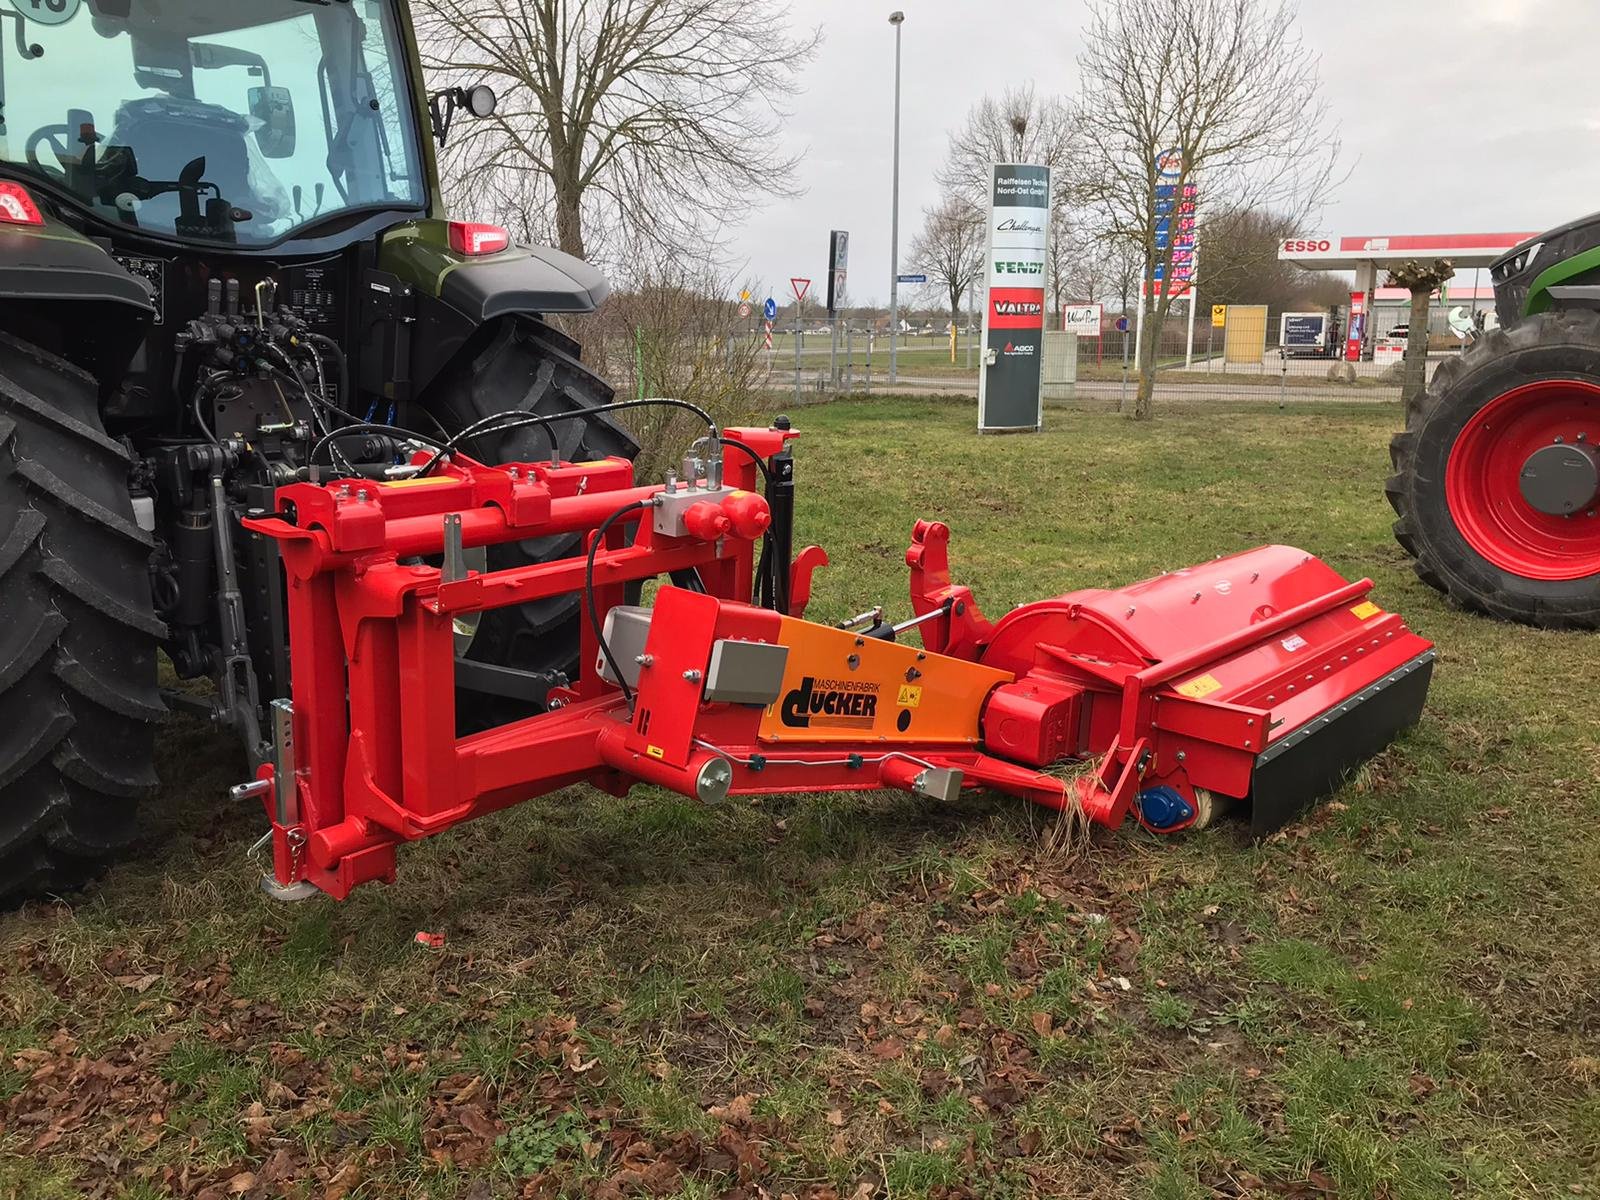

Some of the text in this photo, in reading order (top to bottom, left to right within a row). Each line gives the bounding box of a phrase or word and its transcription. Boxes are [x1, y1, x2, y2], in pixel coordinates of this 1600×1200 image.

[997, 178, 1031, 186] Raiffeisen
[997, 187, 1029, 195] Nord-Ost
[1284, 240, 1331, 252] ESSO
[994, 262, 1044, 274] FENDT
[994, 300, 1041, 315] VALTRA
[814, 679, 880, 693] MASCHINENFABRIK
